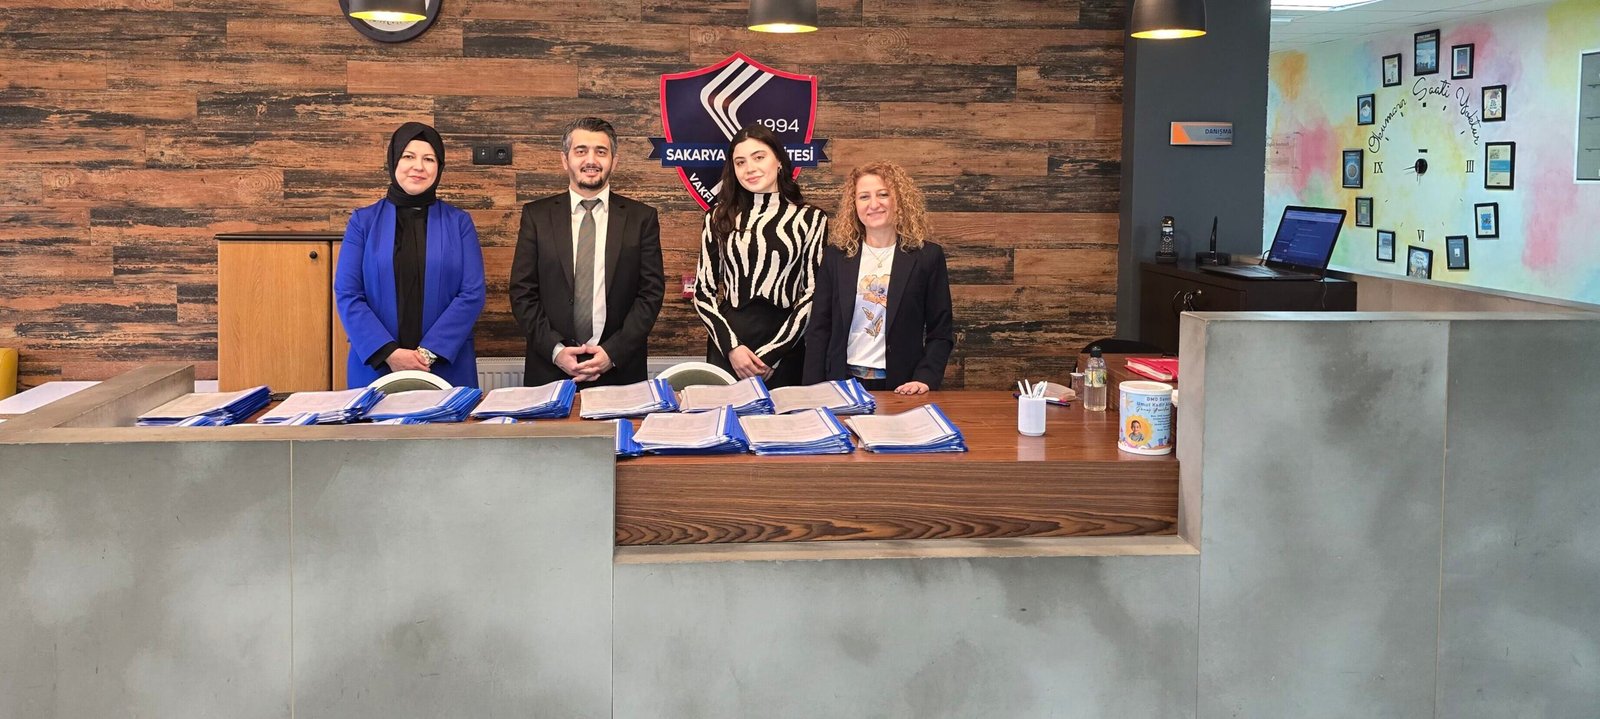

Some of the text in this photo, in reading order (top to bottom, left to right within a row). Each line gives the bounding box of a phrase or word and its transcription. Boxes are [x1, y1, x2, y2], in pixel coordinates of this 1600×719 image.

[1412, 77, 1451, 101] Saati
[1455, 87, 1482, 145] Yoktur
[666, 148, 726, 161] SAKARYA
[1373, 162, 1384, 173] IX
[1465, 160, 1474, 173] III
[689, 172, 714, 203] VAKFI
[1417, 230, 1425, 242] VI
